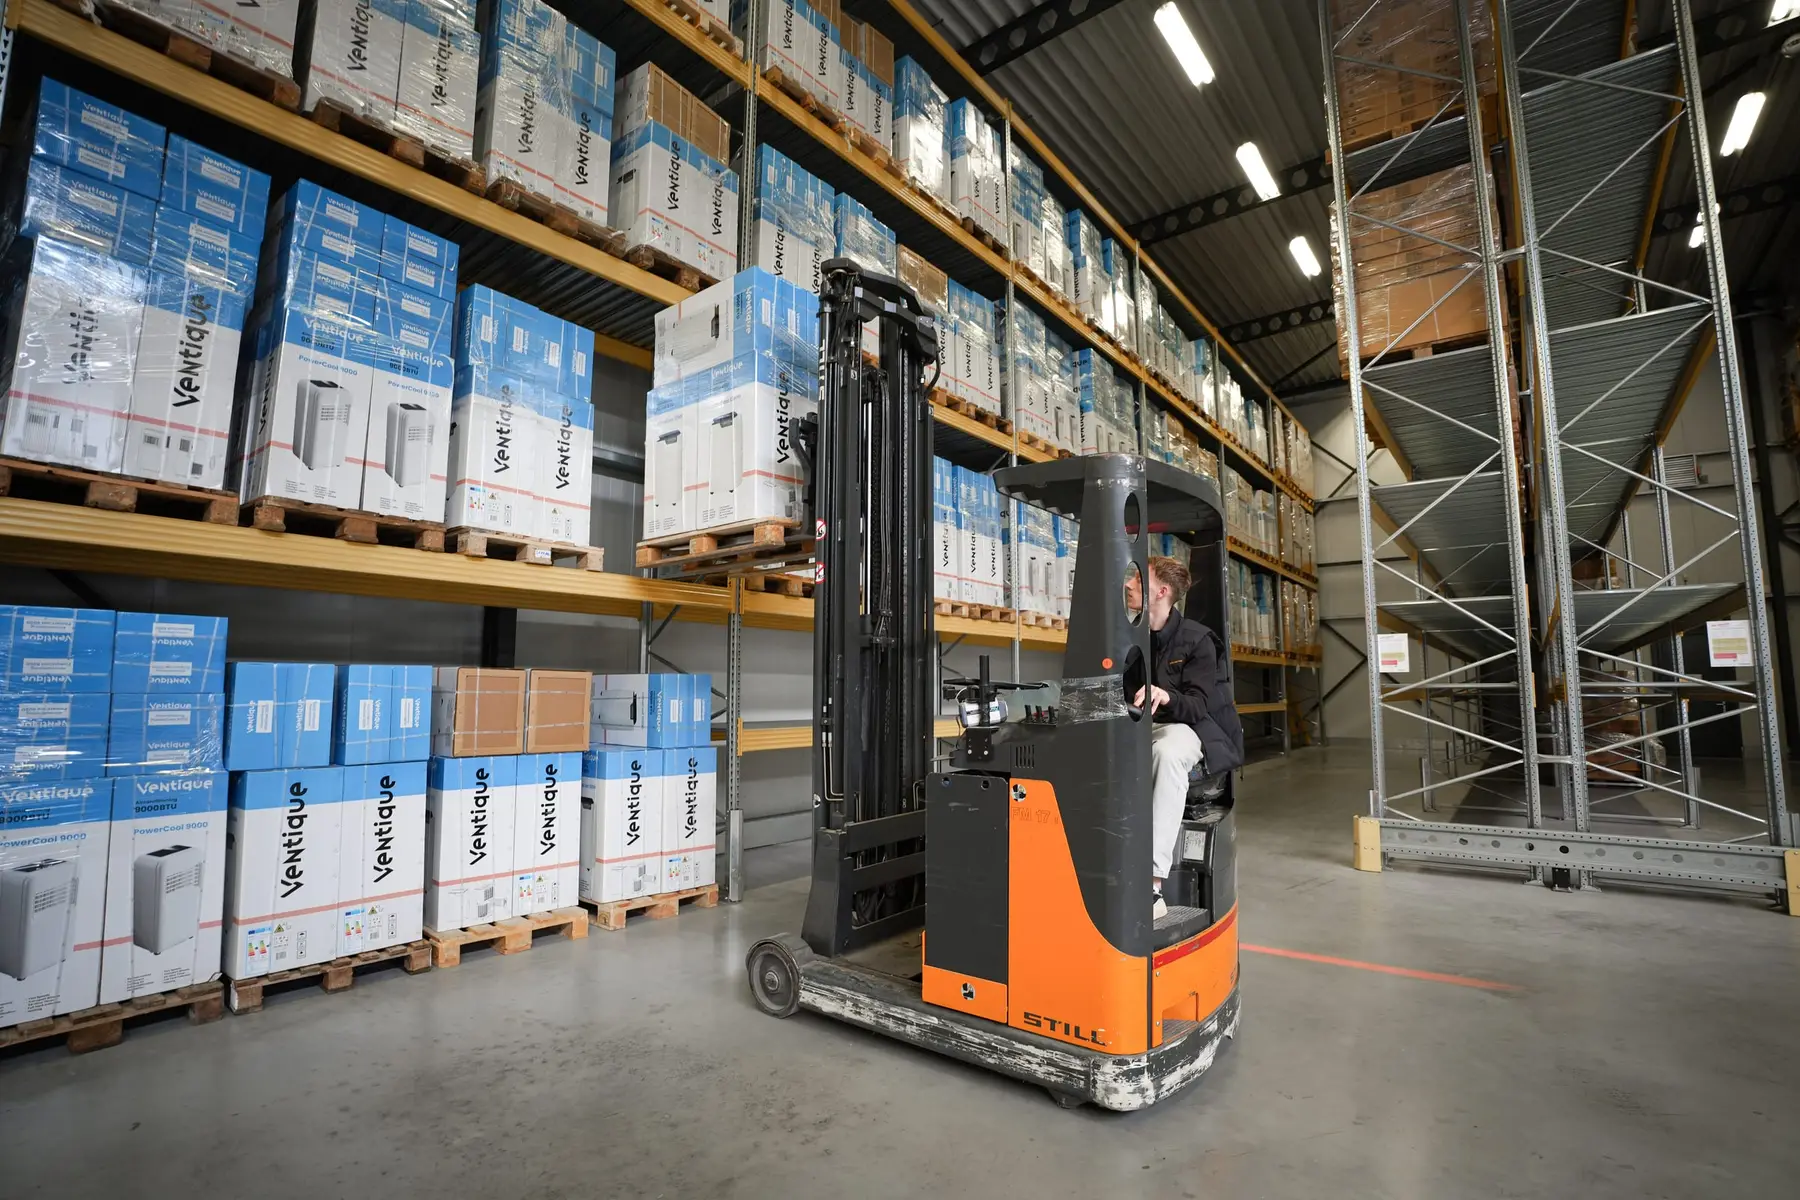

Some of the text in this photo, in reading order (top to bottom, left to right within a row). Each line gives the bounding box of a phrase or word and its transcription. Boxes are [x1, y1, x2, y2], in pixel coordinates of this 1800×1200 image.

[133, 821, 209, 836] PowerCool 9000
[59, 833, 87, 842] 9000
[1023, 1011, 1107, 1047] STILL
